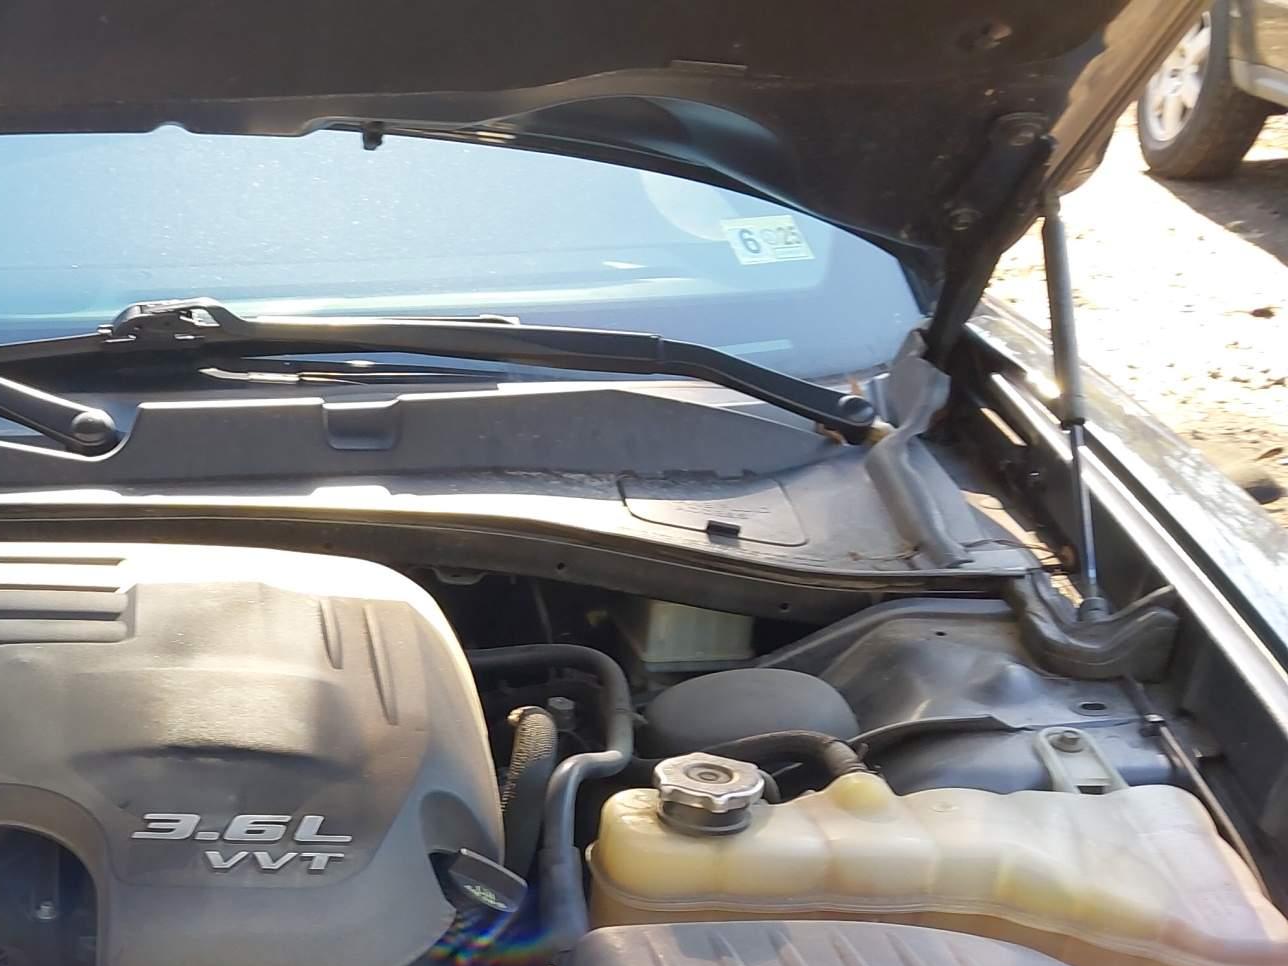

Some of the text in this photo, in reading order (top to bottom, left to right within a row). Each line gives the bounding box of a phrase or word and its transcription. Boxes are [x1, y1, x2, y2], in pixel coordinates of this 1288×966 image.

[738, 228, 762, 254] 6
[130, 813, 353, 843] 3.6L
[204, 850, 346, 874] VVT
